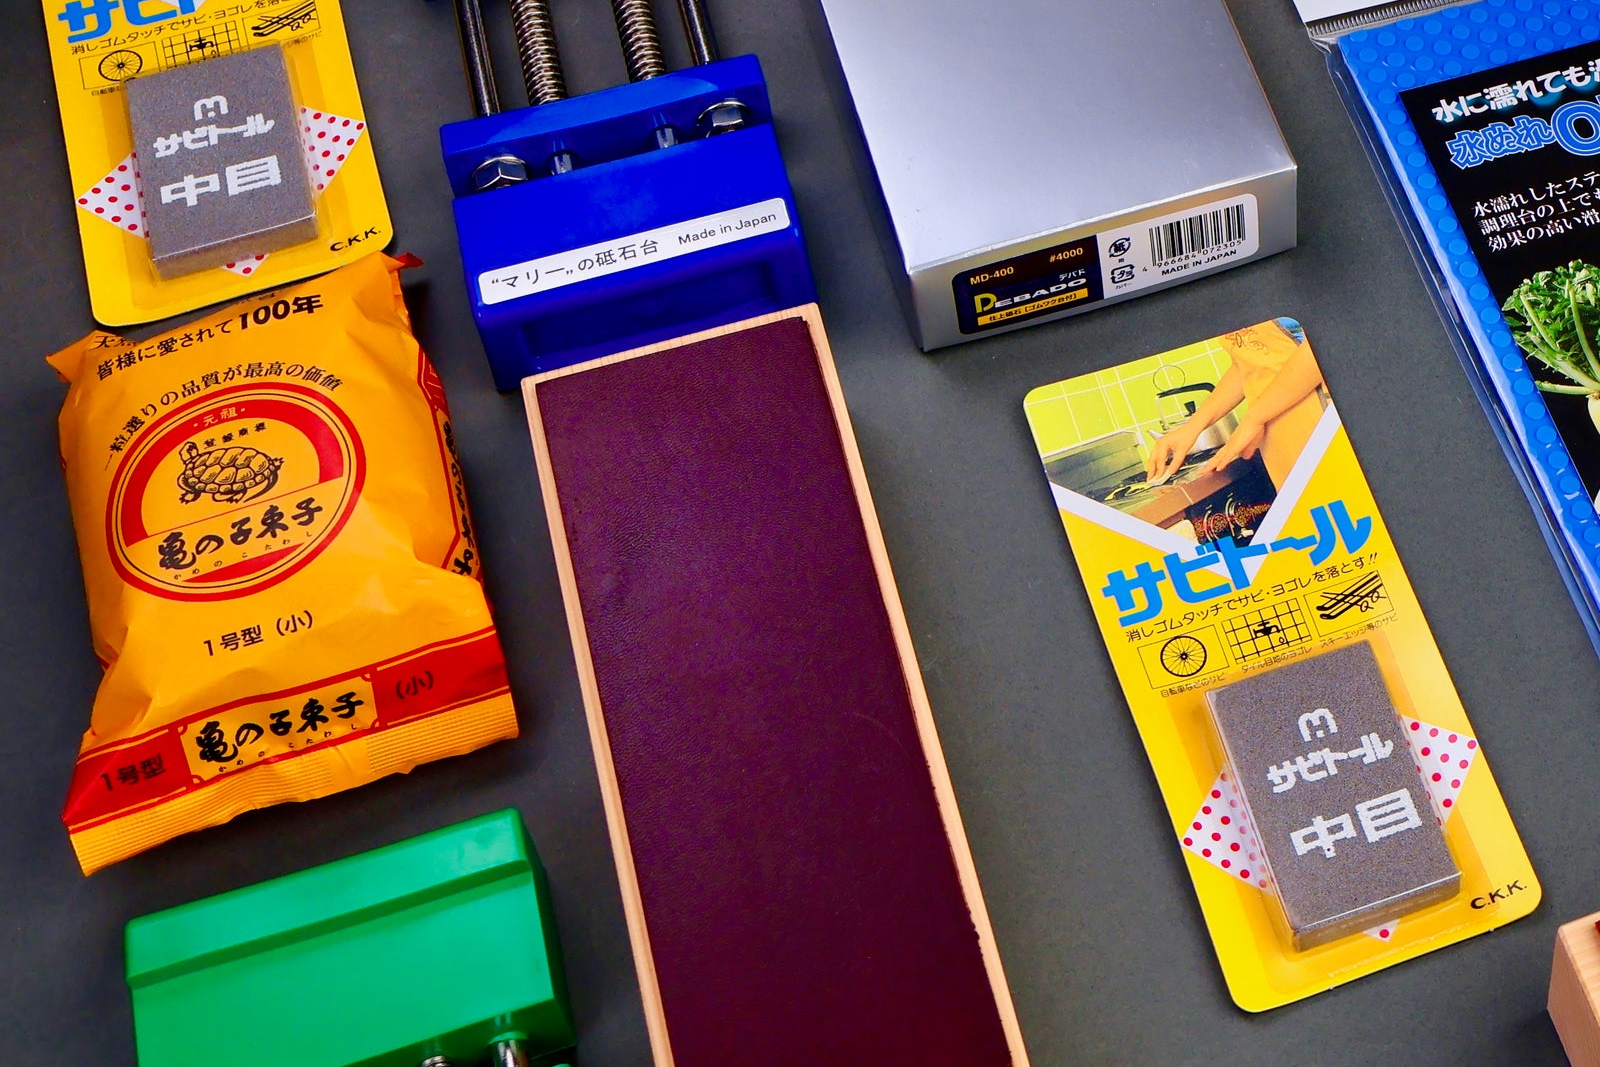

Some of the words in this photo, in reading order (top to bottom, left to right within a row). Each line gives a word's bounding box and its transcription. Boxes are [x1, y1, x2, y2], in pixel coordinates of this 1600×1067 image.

[153, 113, 275, 158] サビトール
[160, 155, 282, 207] 中目
[330, 228, 381, 252] C.K.K.
[678, 227, 716, 245] Made
[720, 224, 733, 235] in
[735, 212, 777, 232] Japan
[1049, 247, 1084, 264] #4000
[1157, 253, 1197, 270] 966684
[1202, 239, 1243, 256] 072305
[1161, 262, 1190, 277] MADE
[1192, 259, 1203, 268] IN
[1204, 248, 1237, 265] JAPAN
[969, 266, 1014, 286] MD-400
[1058, 267, 1086, 282] デバド
[973, 277, 1087, 314] DEBADO
[96, 294, 324, 380] 皆様に愛されて100年
[158, 496, 324, 571] 亀の子束子
[1101, 500, 1373, 627] サビトール
[196, 691, 364, 764] 亀の子束子
[102, 754, 166, 791] 1号型
[1267, 733, 1394, 794] サビトール
[1290, 788, 1423, 858] 中目
[1470, 879, 1527, 910] C.K.K.
